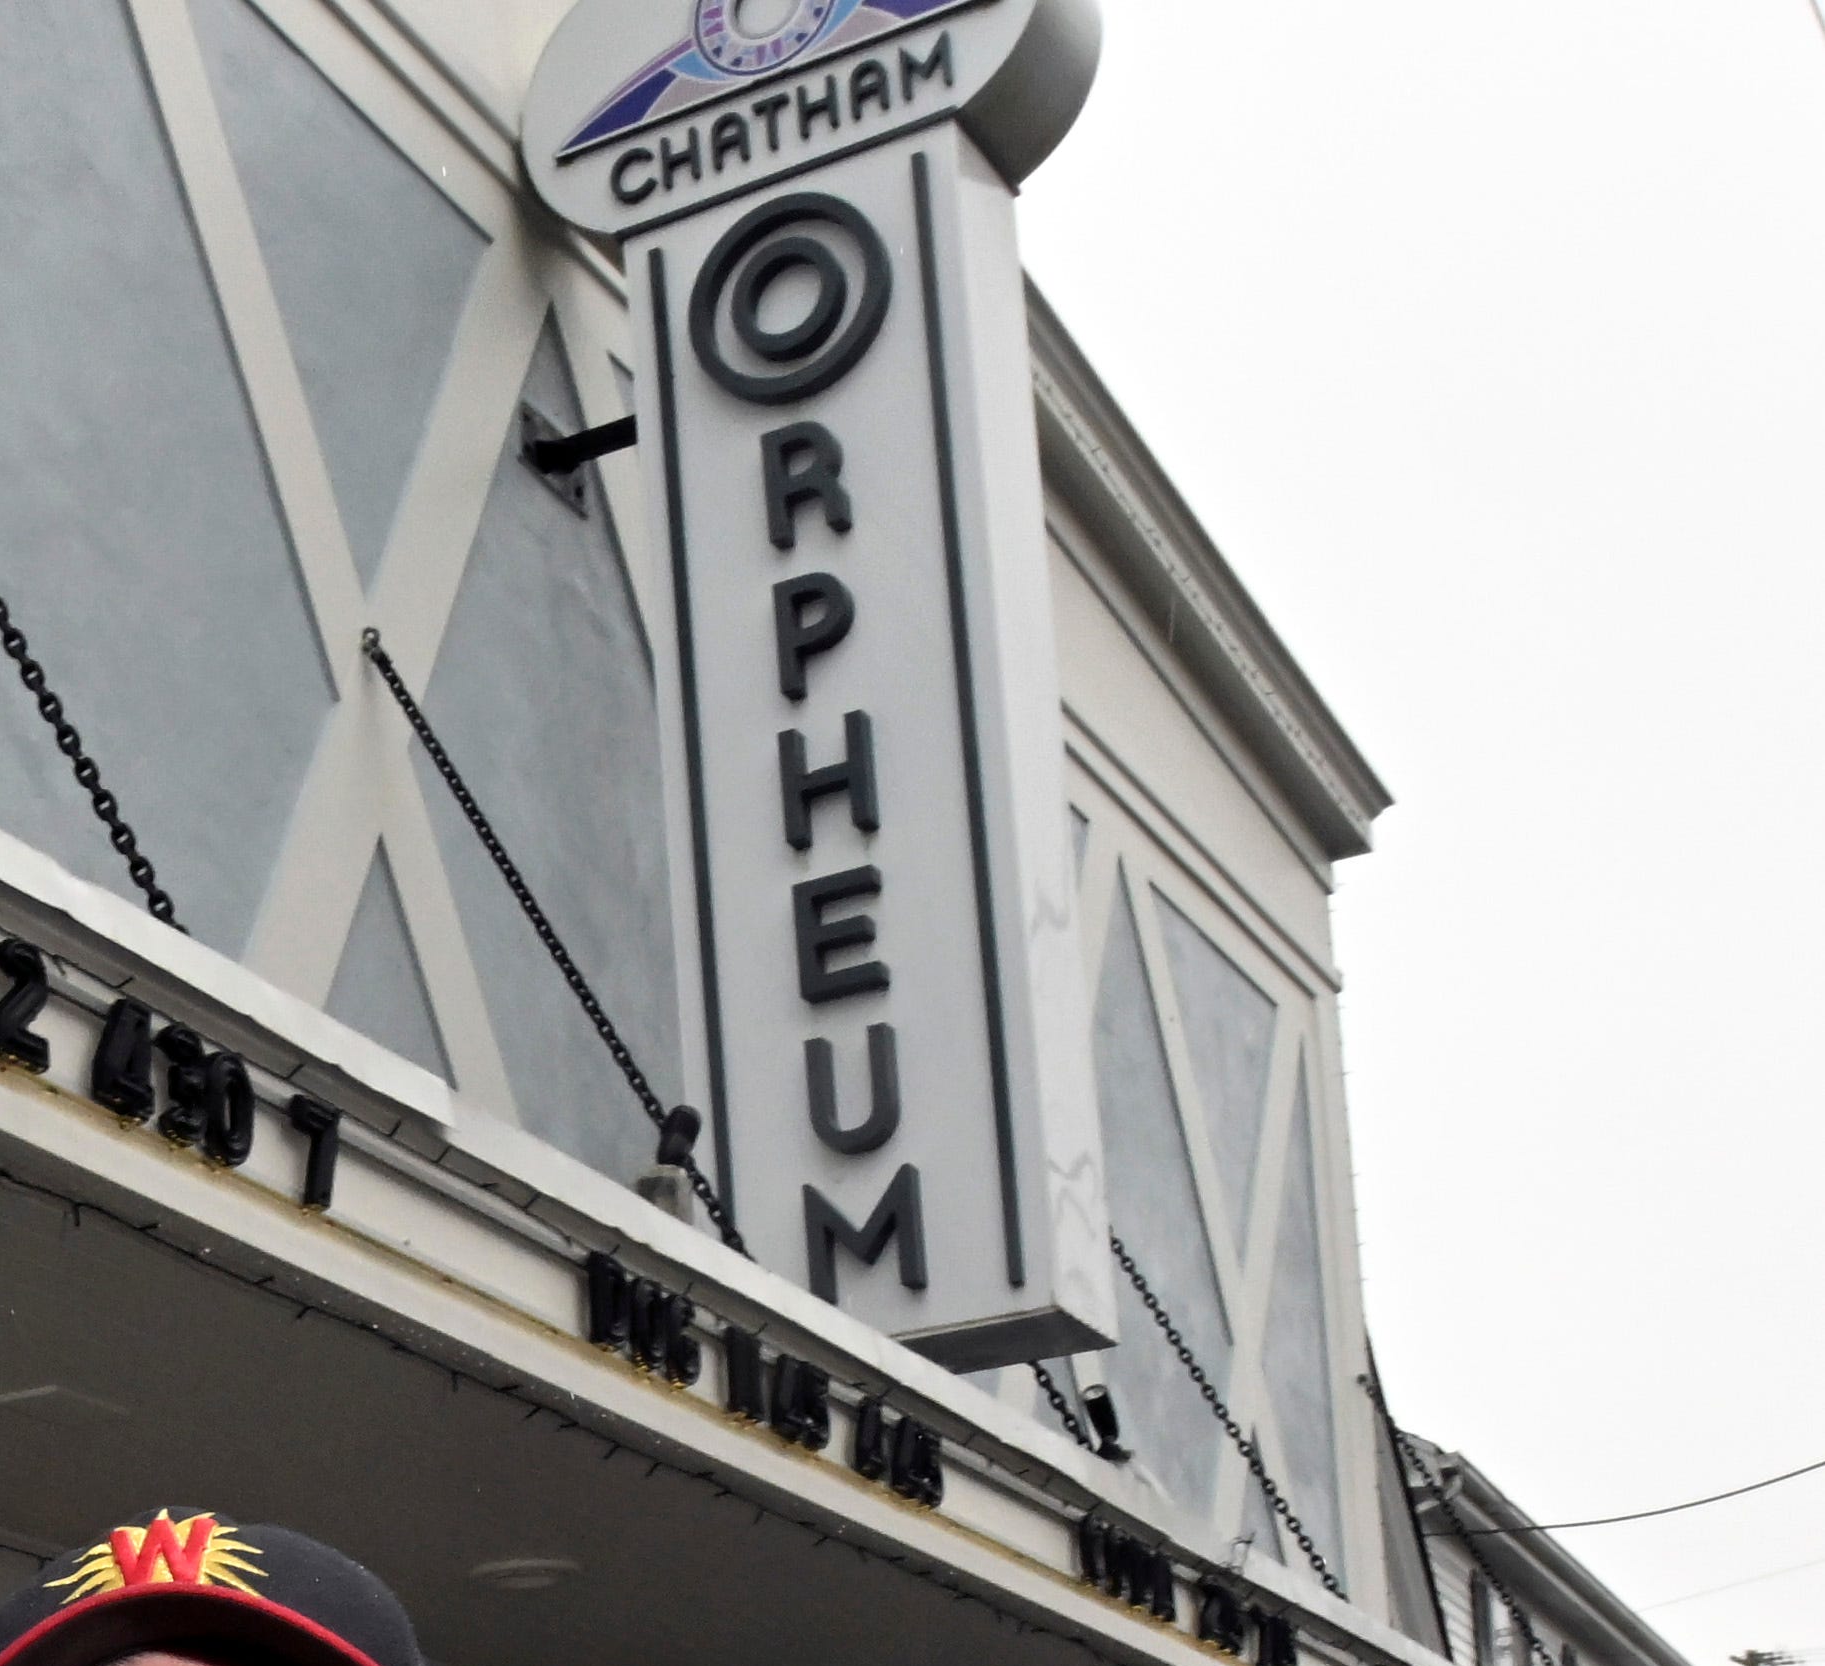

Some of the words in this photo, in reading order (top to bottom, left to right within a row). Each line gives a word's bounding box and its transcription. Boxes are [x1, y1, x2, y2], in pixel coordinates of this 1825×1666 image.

[609, 30, 955, 205] CHATHAM
[688, 191, 928, 1303] ORPHEUM
[91, 998, 254, 1168] 430
[289, 1094, 342, 1210] 7
[108, 1516, 219, 1585] W
